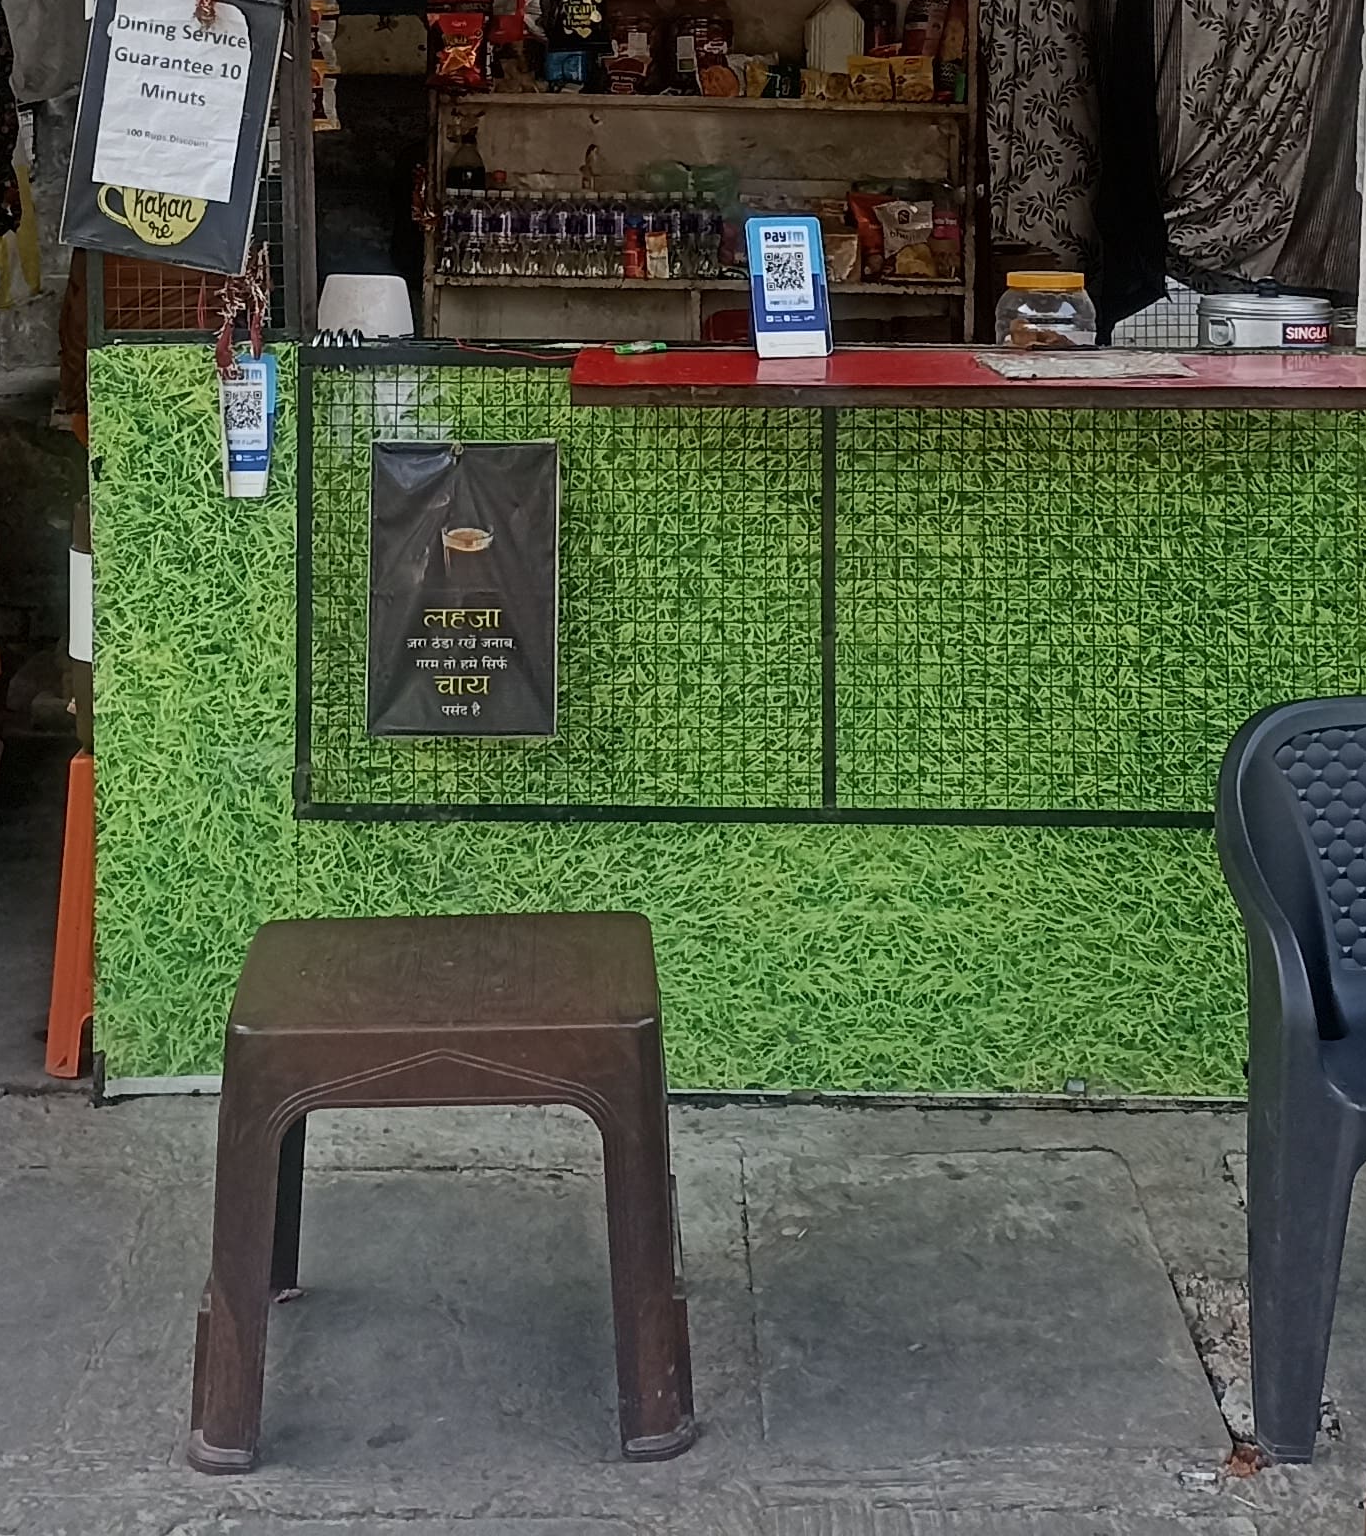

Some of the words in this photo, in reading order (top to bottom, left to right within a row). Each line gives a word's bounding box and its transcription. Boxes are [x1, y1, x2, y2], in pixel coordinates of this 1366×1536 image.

[117, 14, 176, 41] Dining
[182, 25, 248, 49] Service
[115, 47, 213, 75] Guarantee
[221, 63, 241, 80] 10
[141, 83, 206, 107] Minuts
[1286, 327, 1327, 340] SINGLA
[433, 676, 491, 695] चाय
